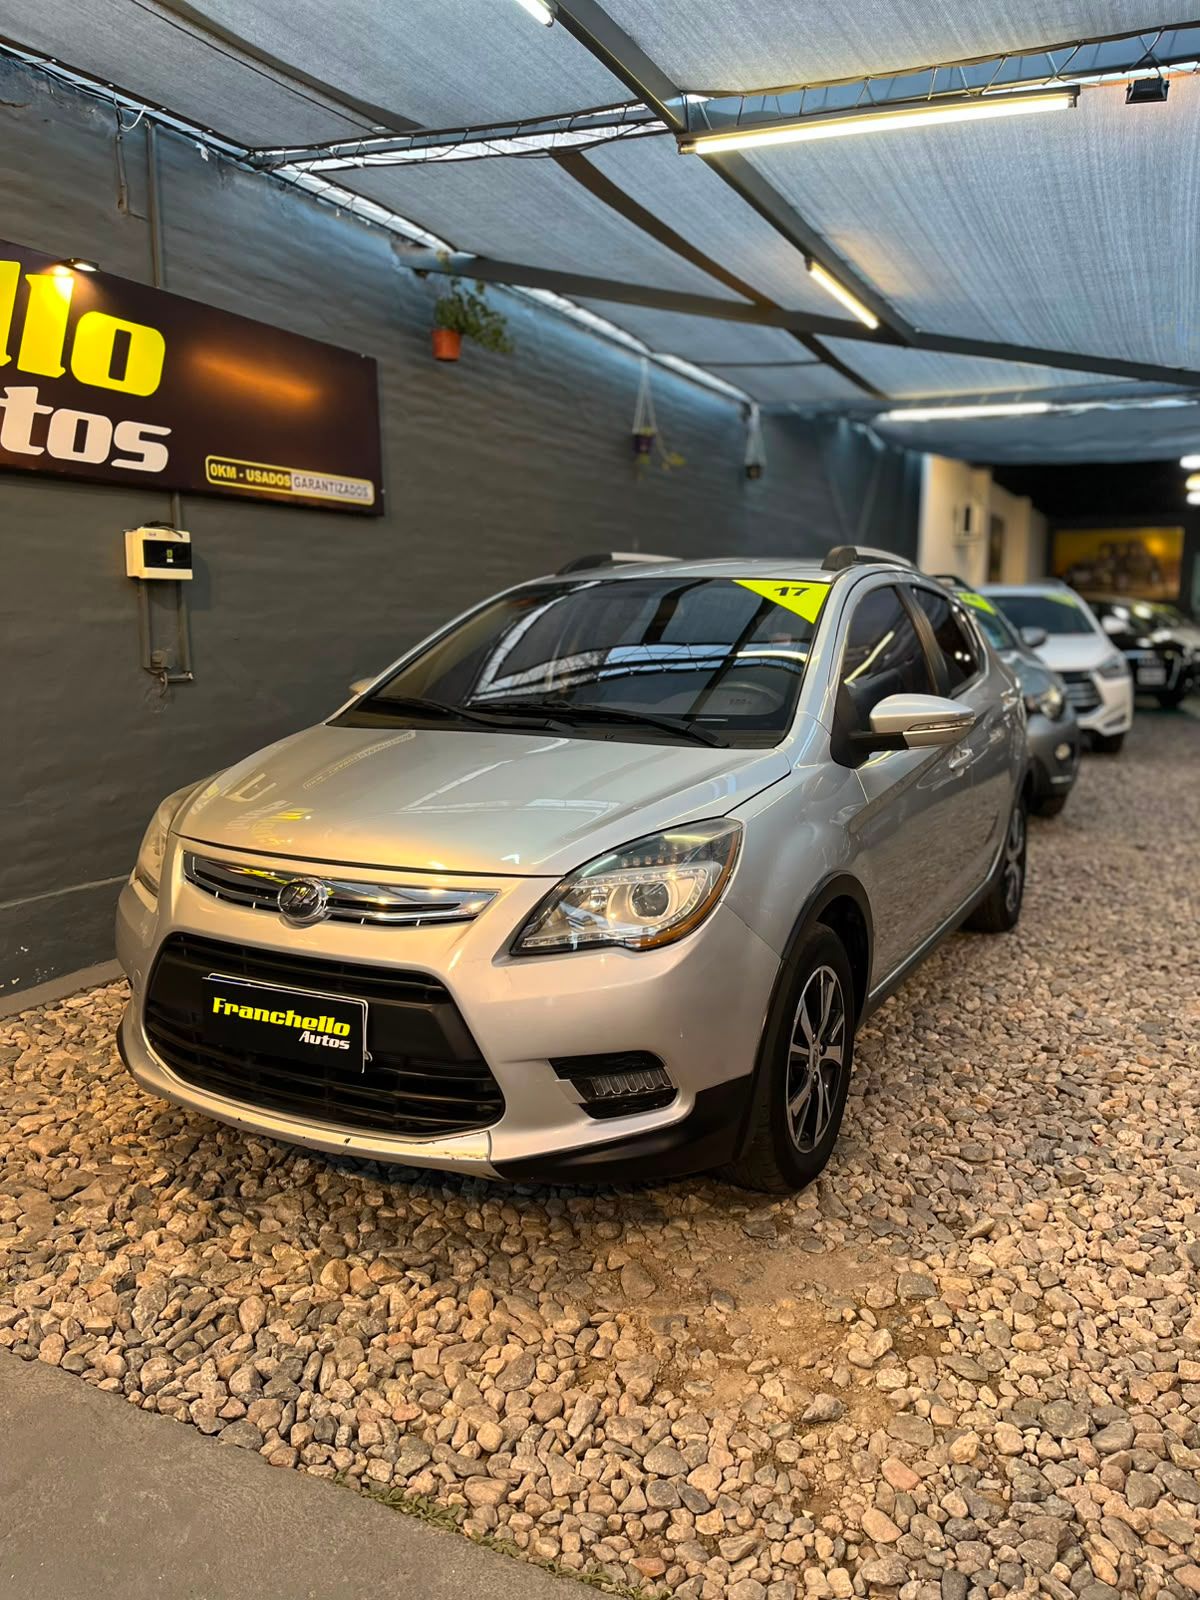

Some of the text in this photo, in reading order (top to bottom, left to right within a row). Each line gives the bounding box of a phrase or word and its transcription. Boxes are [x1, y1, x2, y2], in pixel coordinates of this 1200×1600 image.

[246, 469, 292, 487] USADOS
[293, 476, 369, 497] GARANTIZADOS
[774, 586, 810, 597] 17
[212, 997, 351, 1037] Franchello
[298, 1030, 351, 1050] Autos
